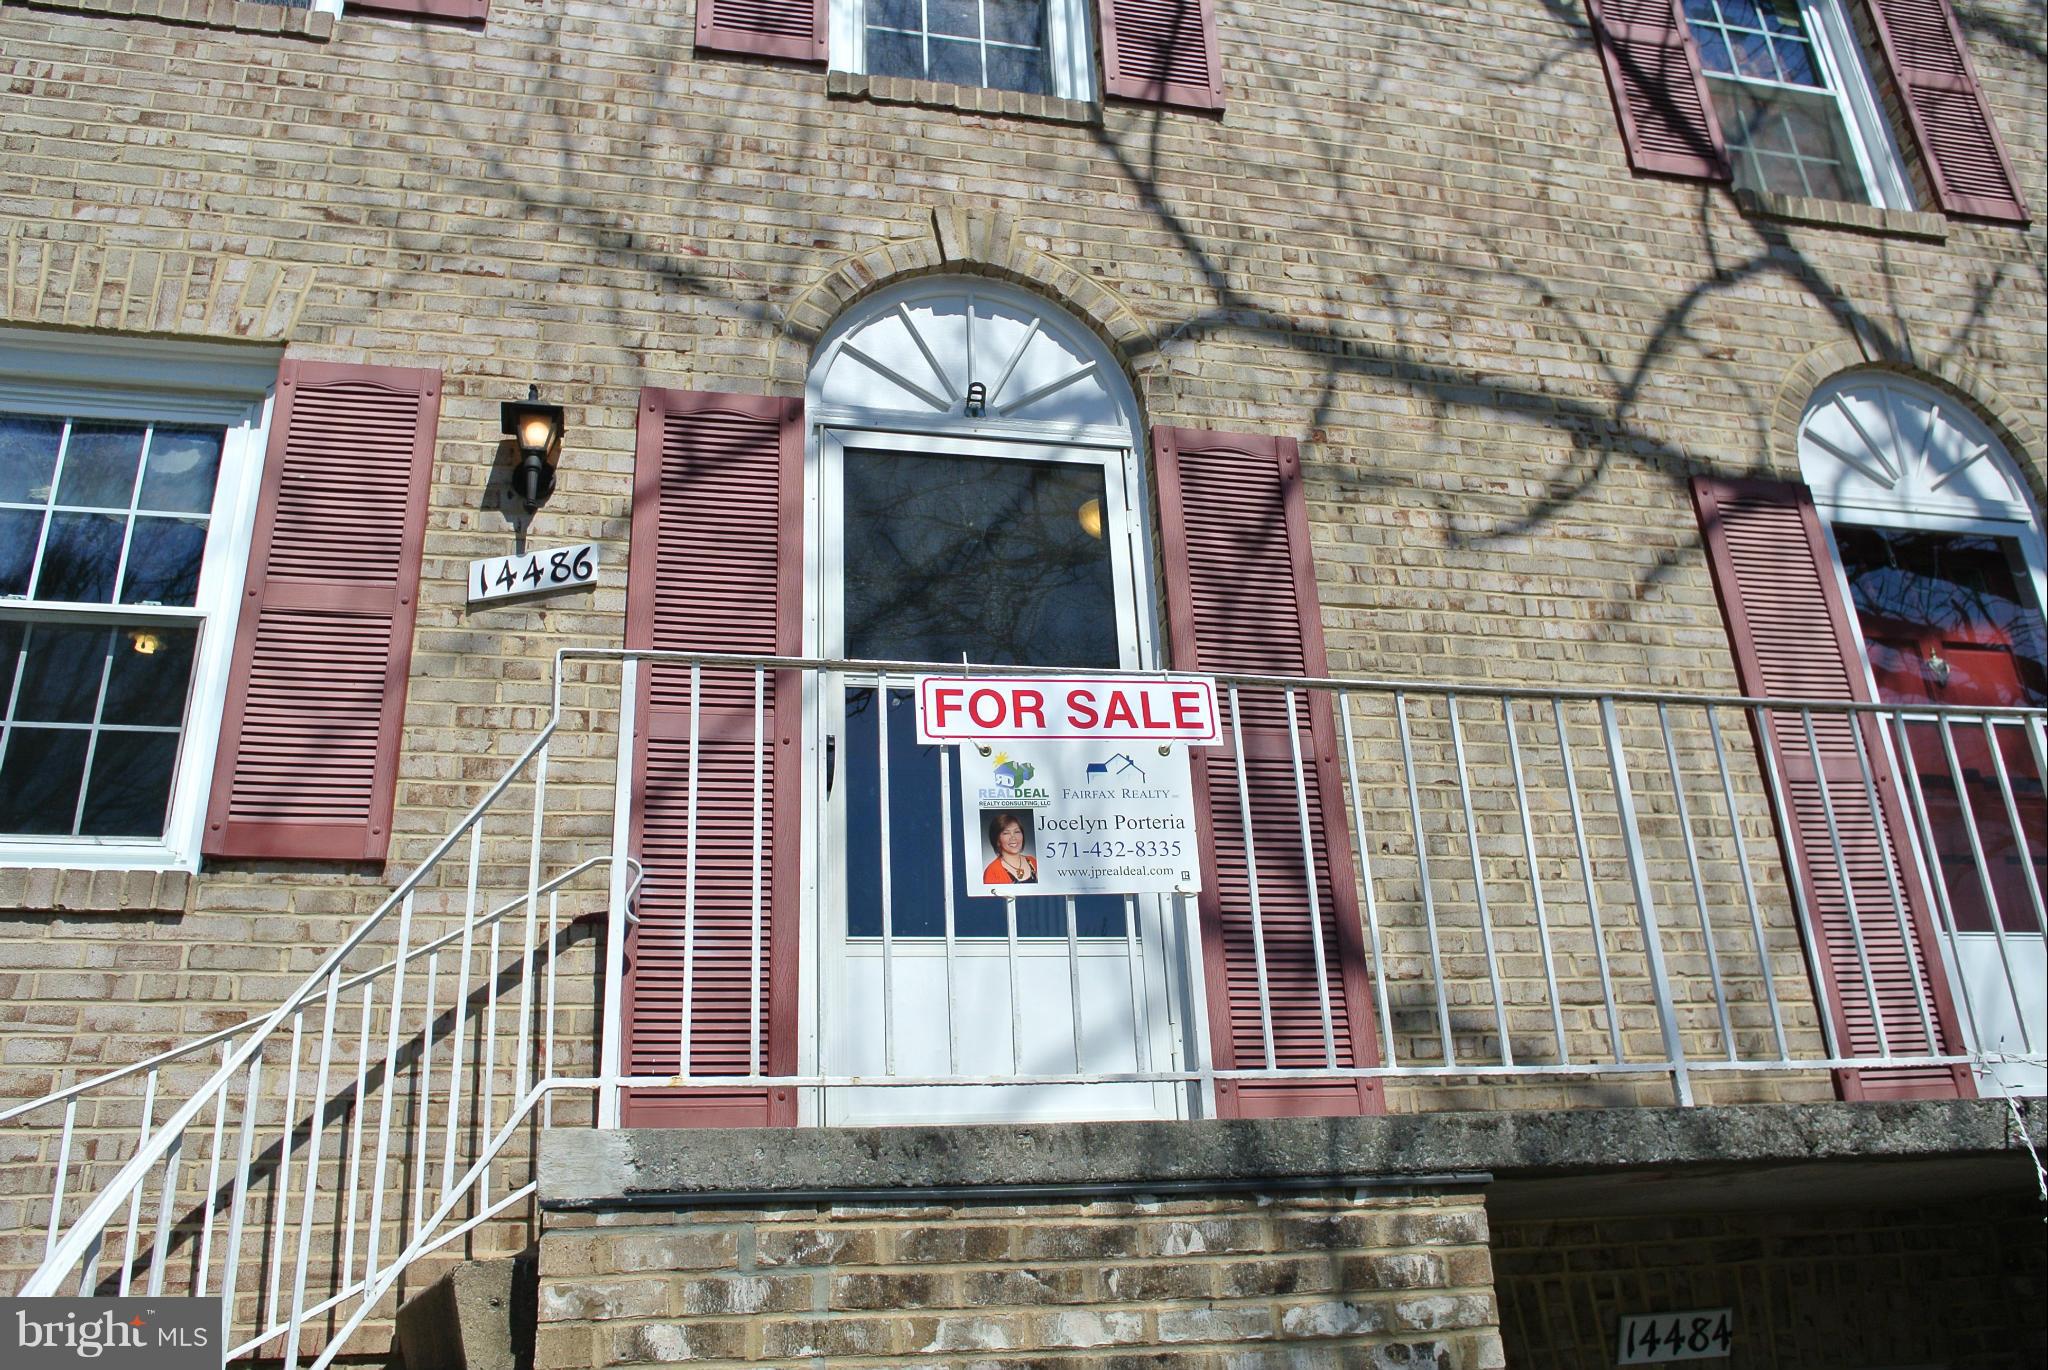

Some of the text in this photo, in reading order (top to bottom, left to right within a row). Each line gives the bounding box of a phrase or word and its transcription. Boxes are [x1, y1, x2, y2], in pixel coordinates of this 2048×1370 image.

[480, 546, 593, 597] 14486
[935, 688, 1204, 729] FOR SALE
[1062, 788, 1115, 799] FAIRFAX
[1121, 788, 1170, 799] REALTY
[1038, 813, 1185, 835] Jocelyn Porteria
[1046, 840, 1181, 859] 571-432-8335
[1057, 866, 1174, 879] www.jprealdeal.com
[1627, 1313, 1733, 1358] 14484
